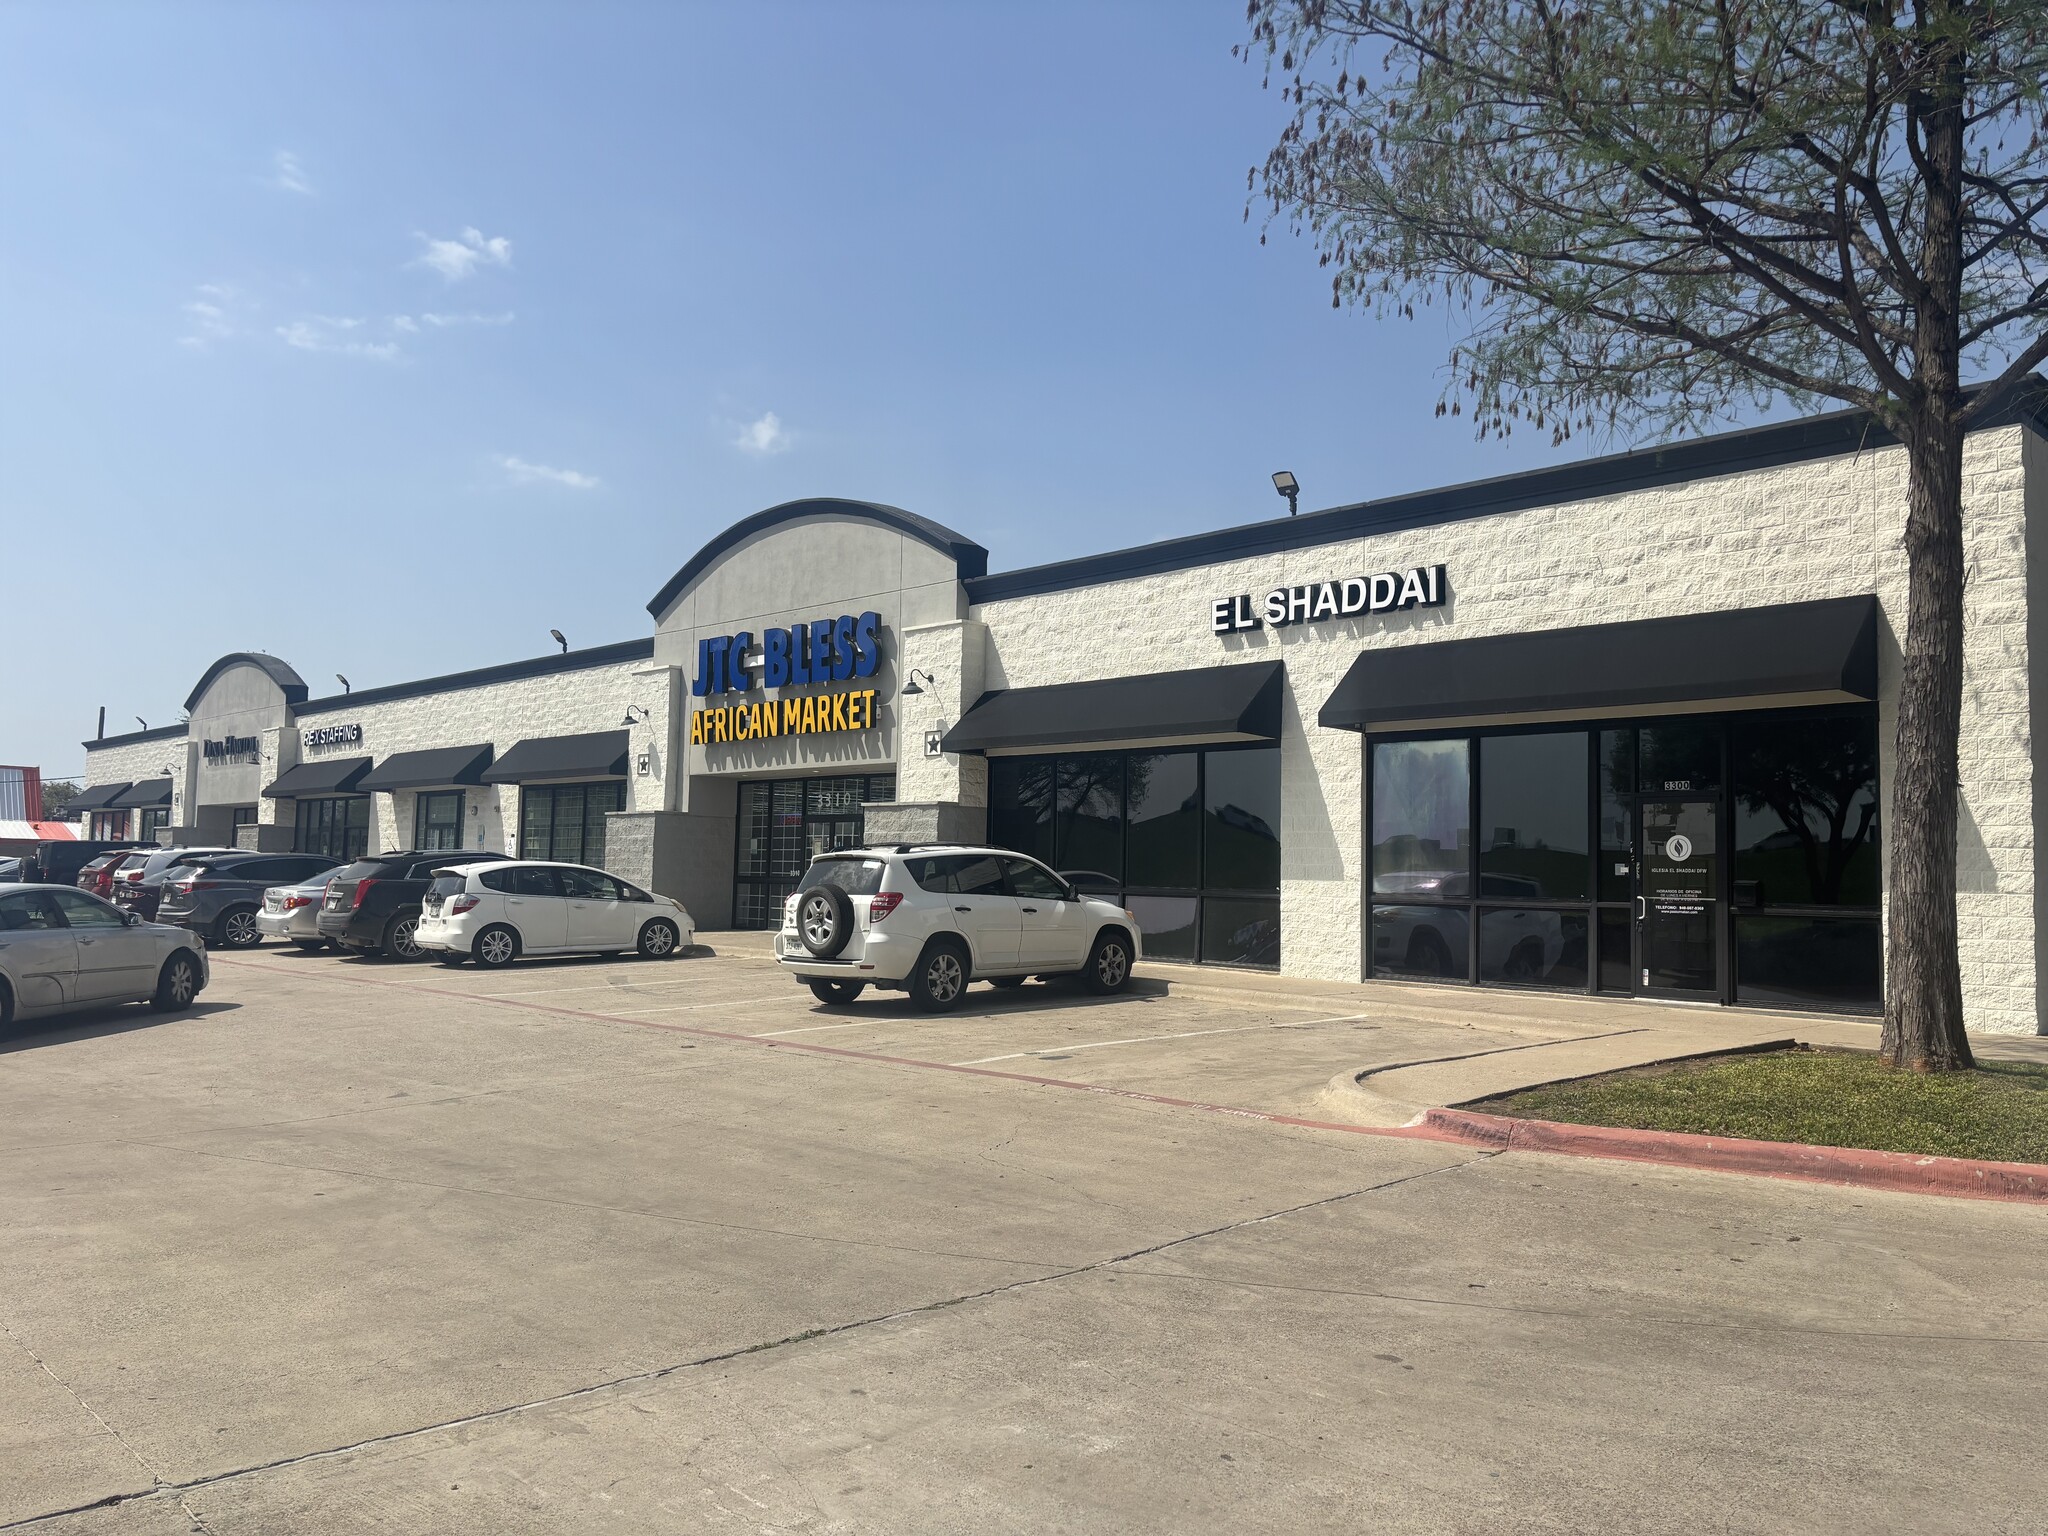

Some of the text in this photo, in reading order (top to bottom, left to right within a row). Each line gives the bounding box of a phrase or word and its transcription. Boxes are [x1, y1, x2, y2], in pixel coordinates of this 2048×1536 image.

[1210, 563, 1446, 636] EL SHADDAI
[692, 611, 882, 697] JTC BLESS
[303, 724, 360, 747] REX STAFFING
[690, 689, 880, 745] AFRICAN MARKET
[817, 792, 851, 808] 3310
